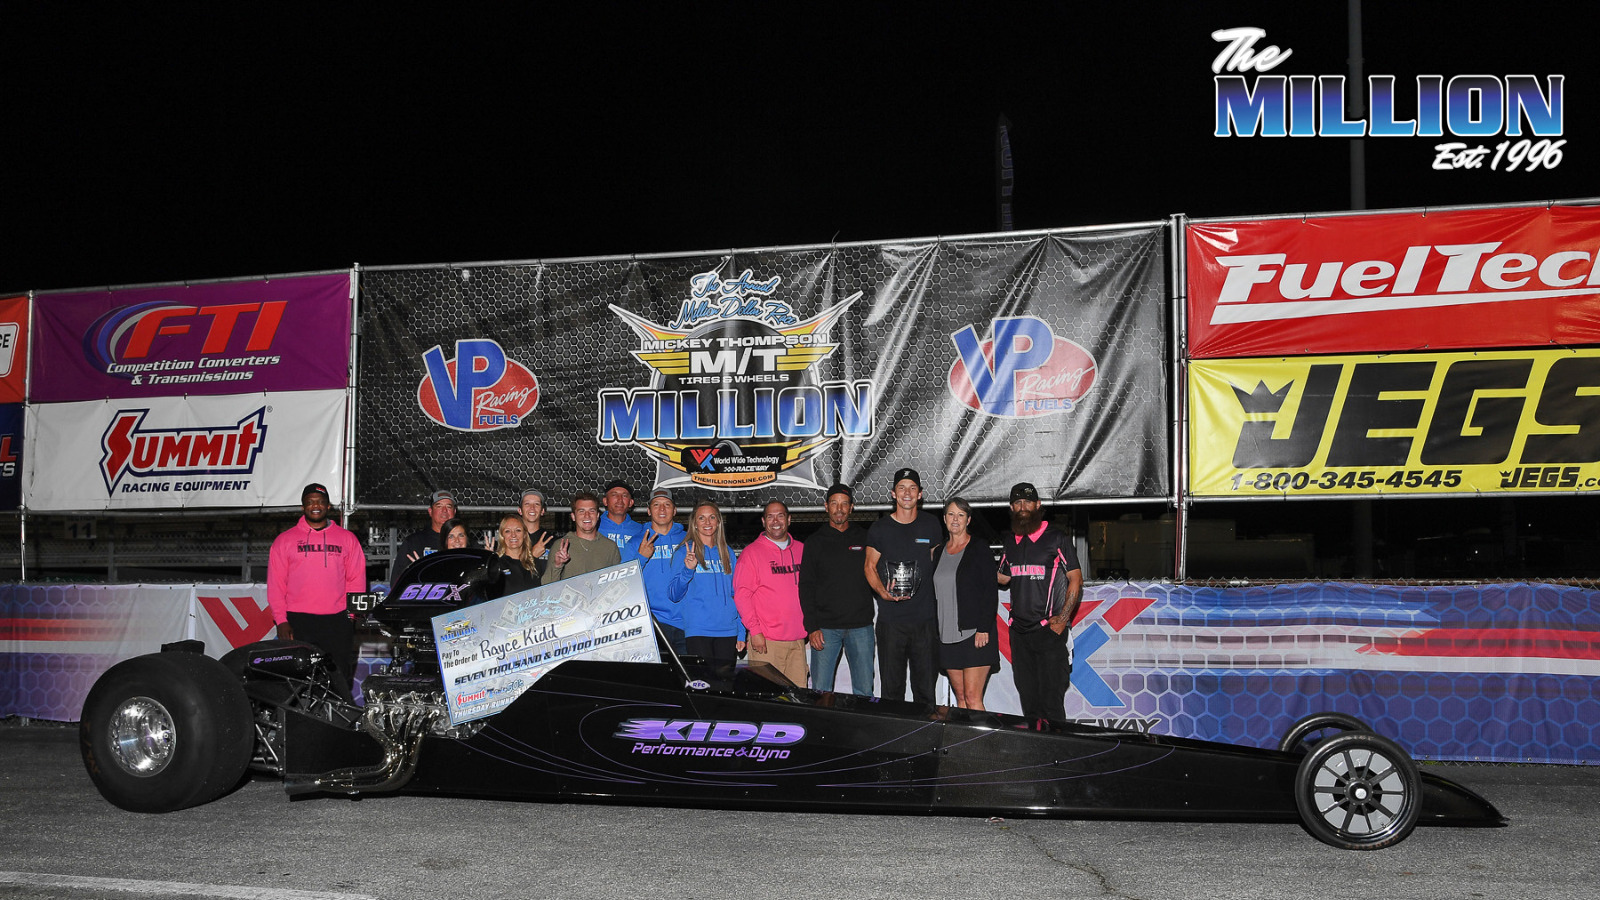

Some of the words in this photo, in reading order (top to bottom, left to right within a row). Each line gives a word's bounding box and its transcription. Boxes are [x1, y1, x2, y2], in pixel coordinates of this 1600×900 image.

[693, 273, 720, 298] The
[722, 271, 779, 294] Annual
[670, 300, 719, 329] Million
[720, 296, 763, 318] Dollar
[764, 302, 797, 325] Race
[122, 301, 289, 359] FTI
[643, 338, 713, 350] MICKEY
[715, 333, 827, 348] THOMPSON
[106, 360, 194, 375] Competition
[198, 355, 281, 369] Converters
[690, 347, 787, 375] M/T
[950, 315, 1055, 418] VP
[131, 374, 143, 386] &
[148, 370, 254, 385] Transmissions
[422, 339, 507, 430] VP
[679, 376, 720, 385] TIRES
[734, 374, 790, 384] WHEELS
[1019, 366, 1095, 400] Racing
[476, 386, 538, 418] Racing
[600, 383, 873, 442] MILLION
[1023, 399, 1073, 412] FUELS
[479, 414, 518, 425] FUELS
[731, 456, 746, 464] Wide
[747, 455, 780, 465] Technology
[121, 481, 170, 493] RACING
[173, 479, 251, 492] EQUIPMENT
[693, 474, 774, 485] THEMILLIONONLINE.COM
[1230, 469, 1463, 491] 1-800-345-4545
[1500, 466, 1600, 488] JEGS.c
[68, 522, 91, 538] 11
[298, 544, 342, 553] MILLION
[598, 565, 637, 585] 2023
[400, 583, 470, 601] 616X
[479, 639, 522, 660] Rayce
[523, 623, 559, 646] Kidd
[443, 659, 454, 669] The
[454, 656, 470, 667] Order
[454, 669, 487, 686] SEVEN
[488, 653, 542, 677] THOUSAND
[543, 651, 551, 661] &
[594, 626, 643, 646] DOLLARS
[613, 718, 807, 746] KIDD
